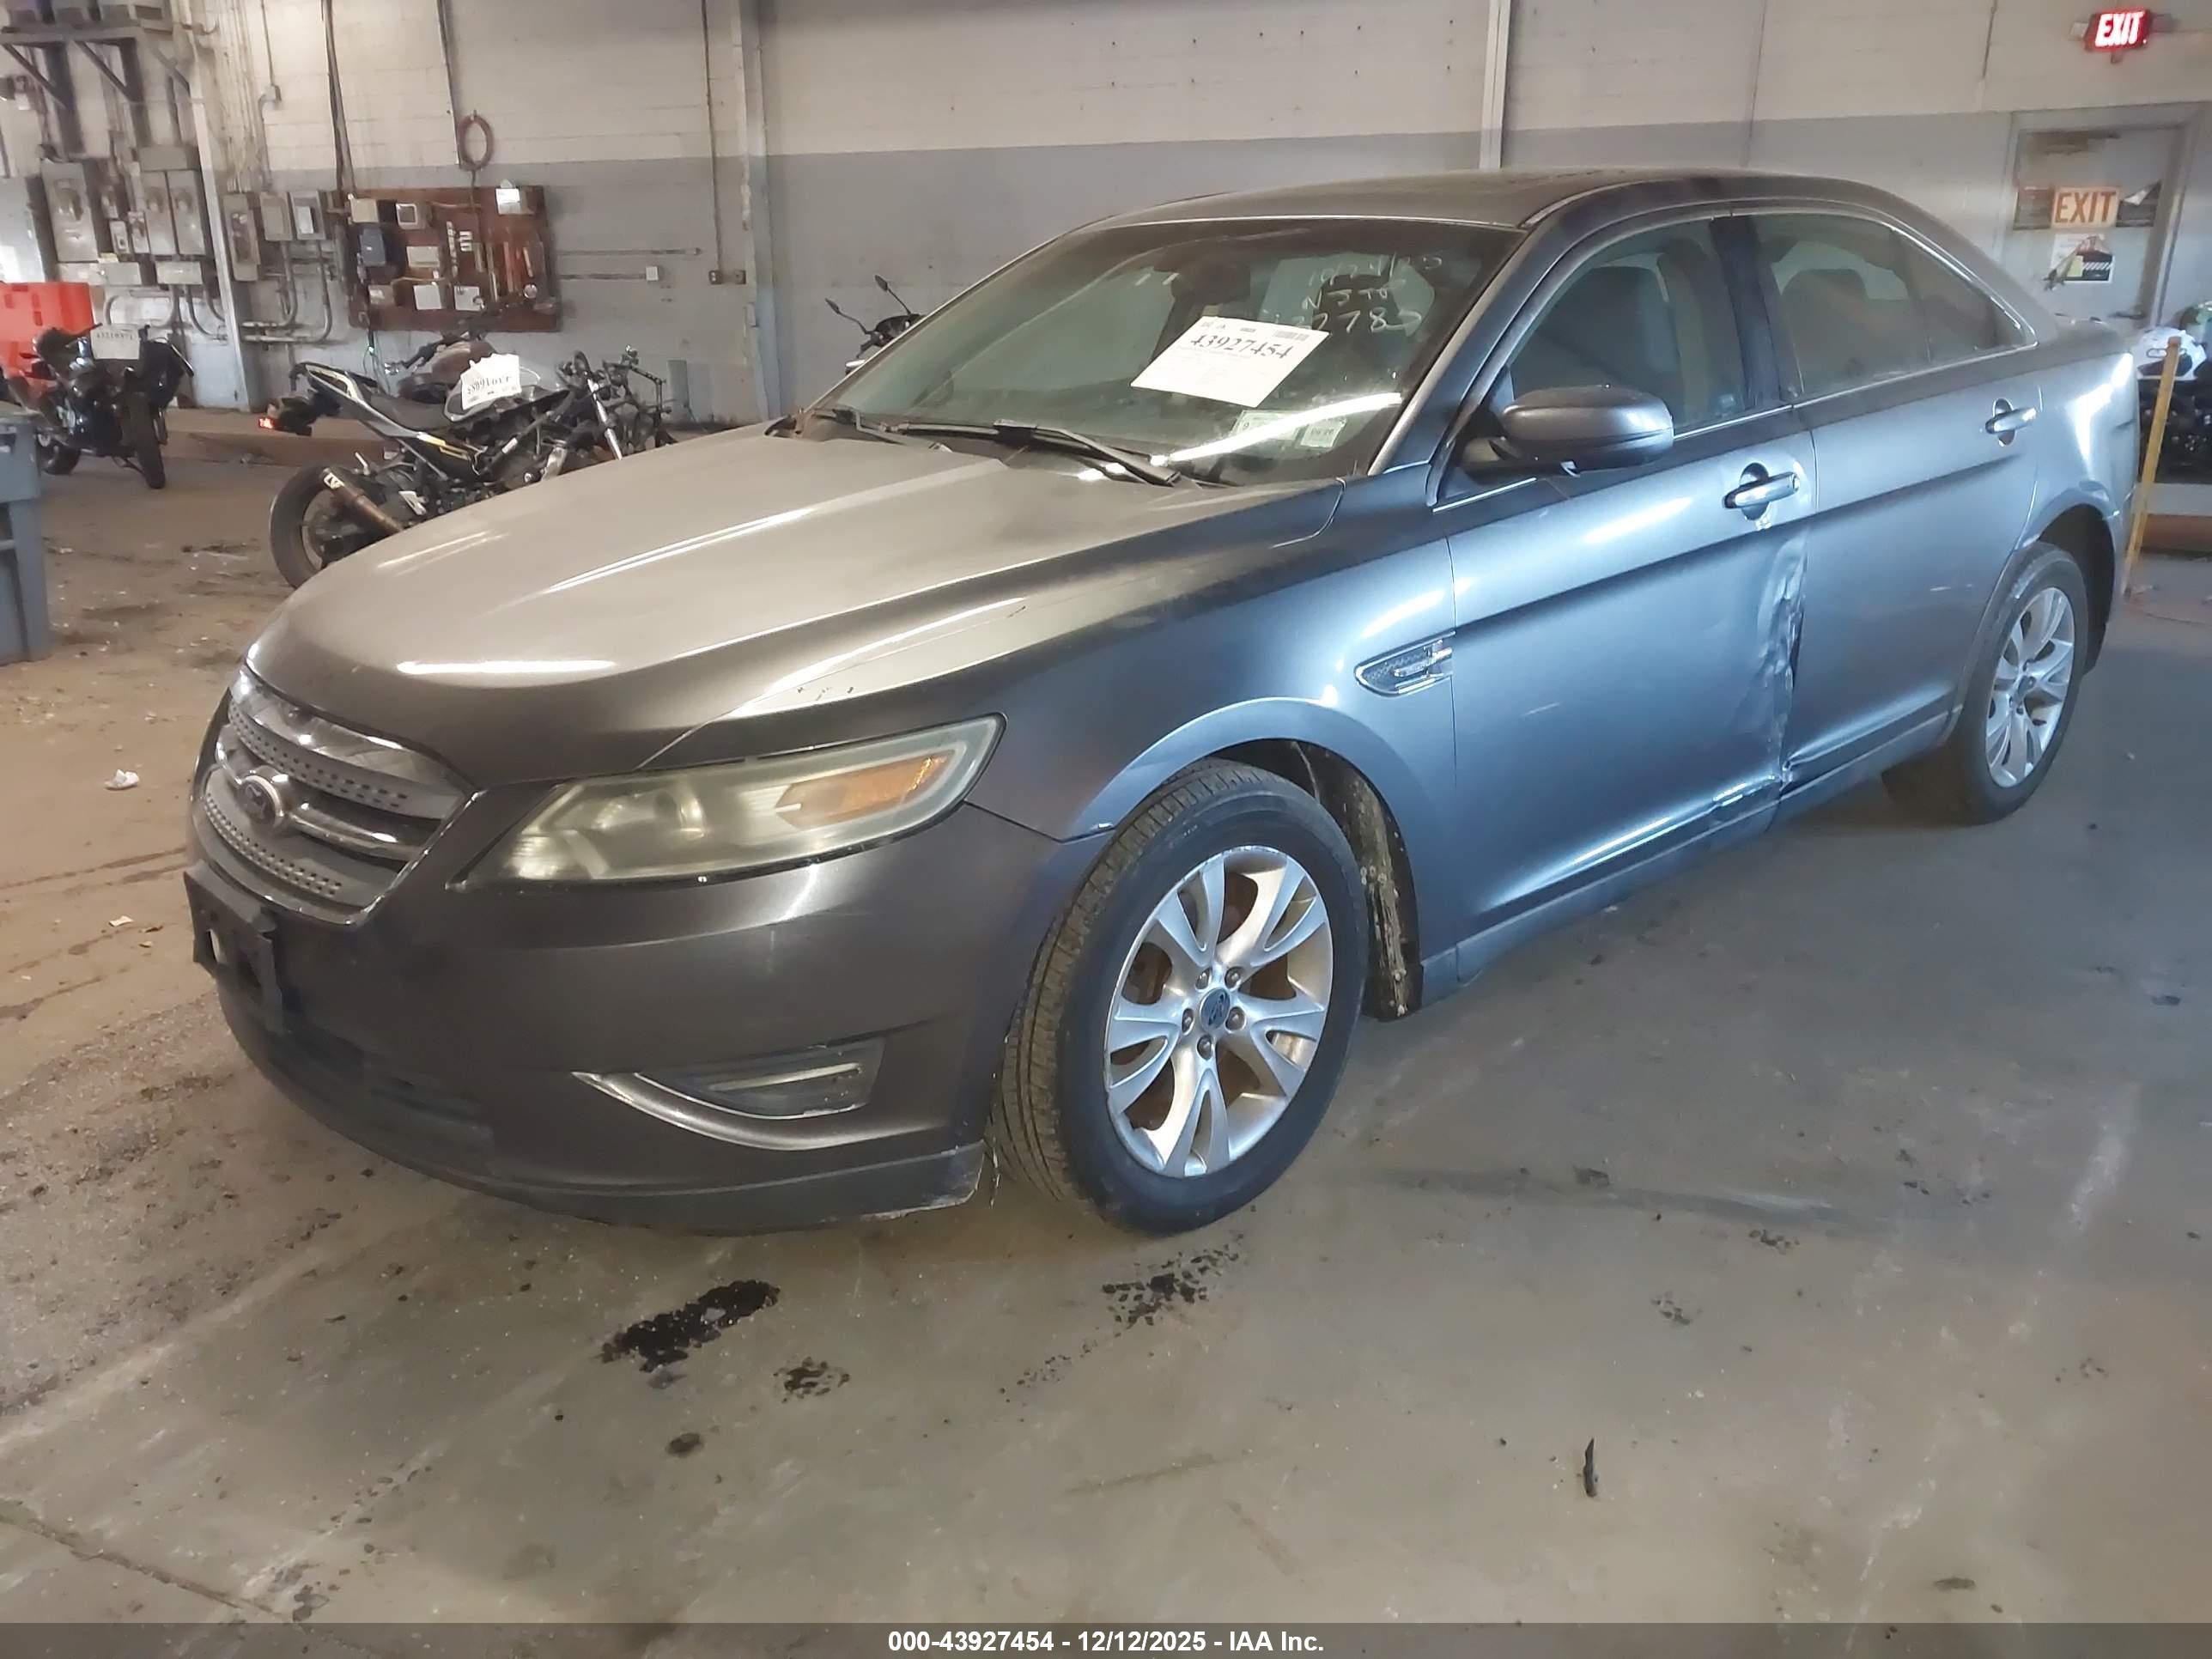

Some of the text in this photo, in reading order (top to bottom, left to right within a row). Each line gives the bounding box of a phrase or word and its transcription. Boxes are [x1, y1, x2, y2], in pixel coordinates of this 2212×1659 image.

[2095, 10, 2146, 47] EXIT
[2054, 191, 2117, 224] EXIT
[1190, 334, 1294, 359] 43927454
